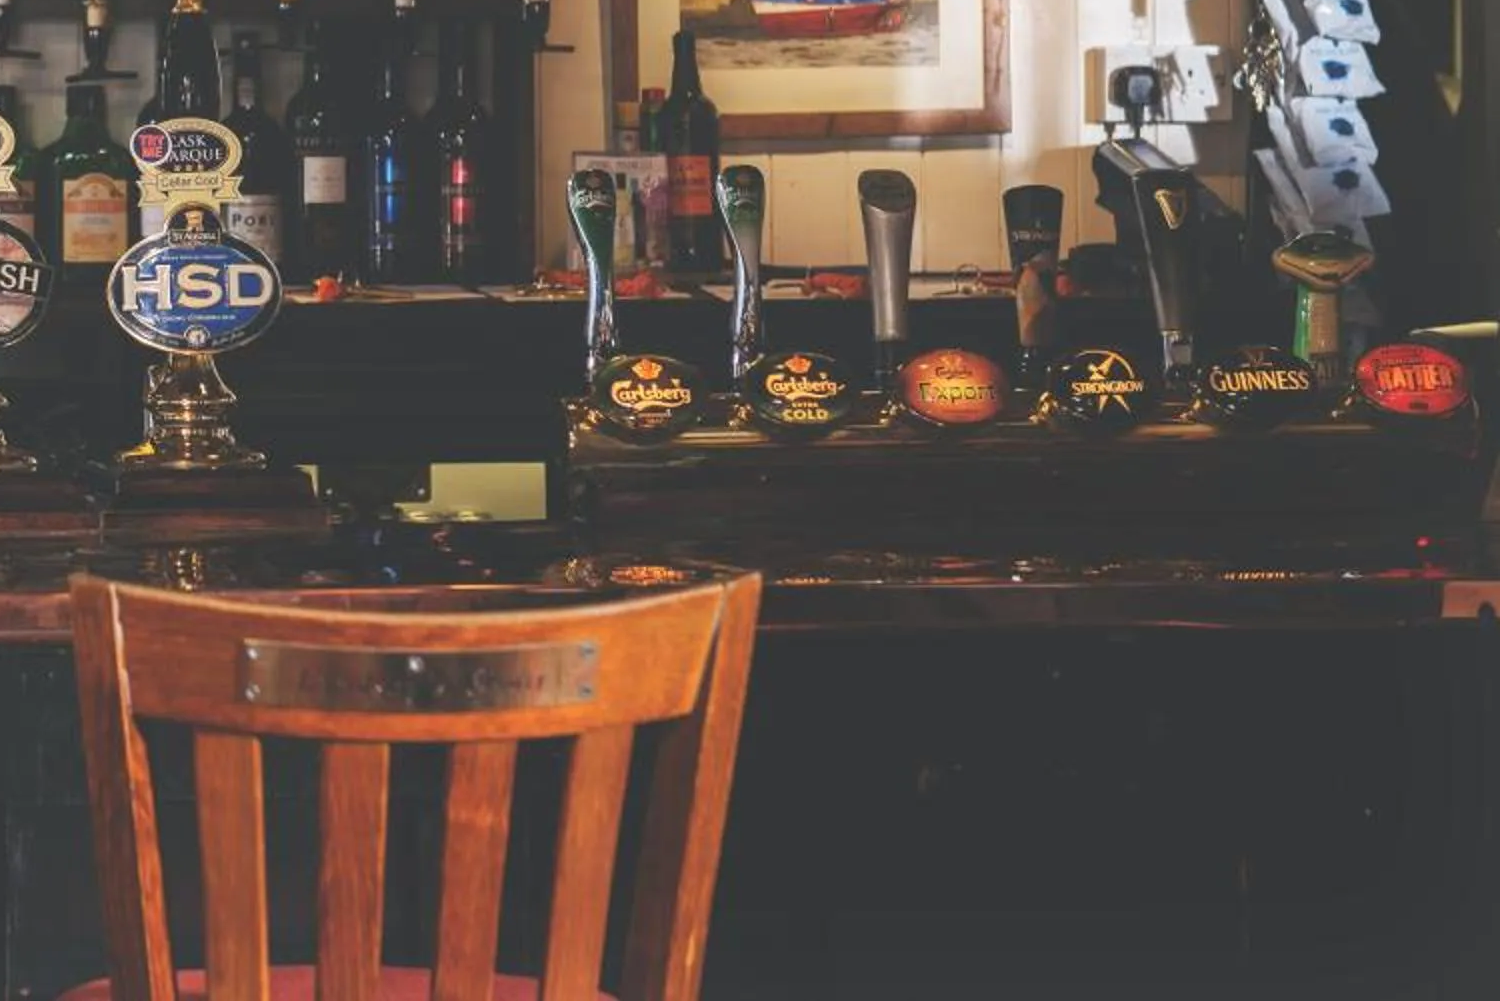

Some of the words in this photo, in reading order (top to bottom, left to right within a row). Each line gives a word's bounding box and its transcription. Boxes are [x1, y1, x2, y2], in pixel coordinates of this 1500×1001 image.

[138, 134, 165, 148] TRY
[141, 146, 163, 159] ME
[167, 147, 224, 163] ARQUE
[160, 175, 192, 188] Cellar
[195, 174, 220, 186] Cool
[121, 263, 274, 312] HSD
[765, 372, 838, 400] Carlsberg
[1070, 379, 1145, 396] STRONGBOW
[1208, 368, 1310, 393] GUINNESS
[611, 378, 692, 411] Carlsberg
[781, 409, 829, 422] COLD
